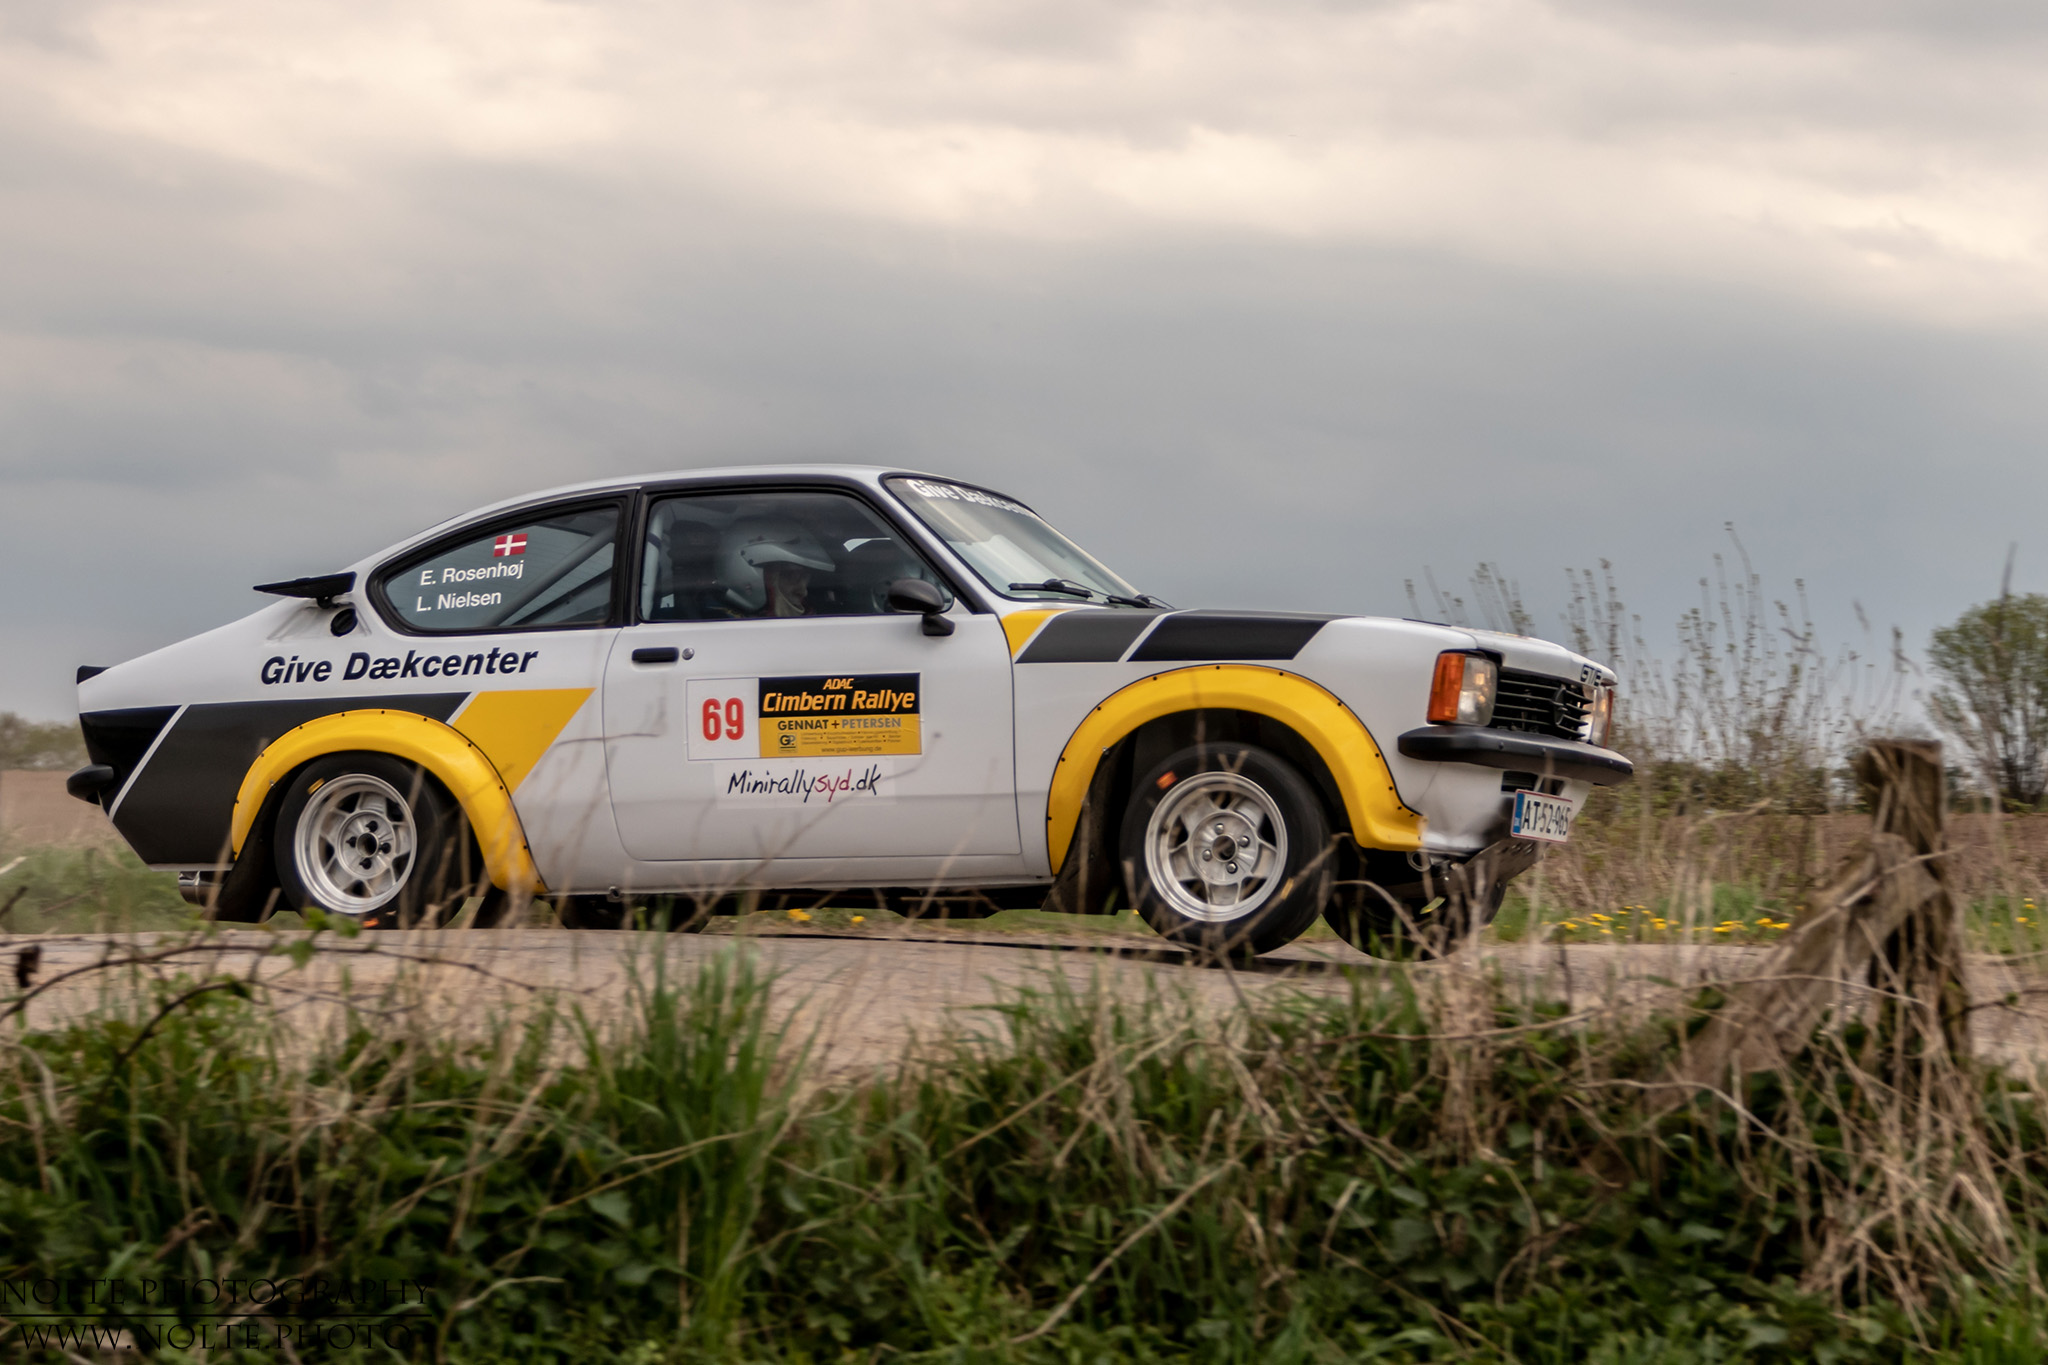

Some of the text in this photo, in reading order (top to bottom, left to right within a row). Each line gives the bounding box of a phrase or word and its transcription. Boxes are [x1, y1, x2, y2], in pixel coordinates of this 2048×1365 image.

[906, 479, 960, 500] Give
[420, 560, 525, 586] E. Rosenhøj
[416, 591, 502, 612] L. Nielsen
[260, 647, 539, 686] Give Dækcenter
[823, 678, 855, 690] ADAC
[762, 689, 916, 713] Cimbern Rallye
[702, 697, 745, 742] 69
[777, 719, 829, 731] GENNAT
[841, 717, 902, 729] PETERSEN
[727, 764, 882, 803] Minirallysyd.dk
